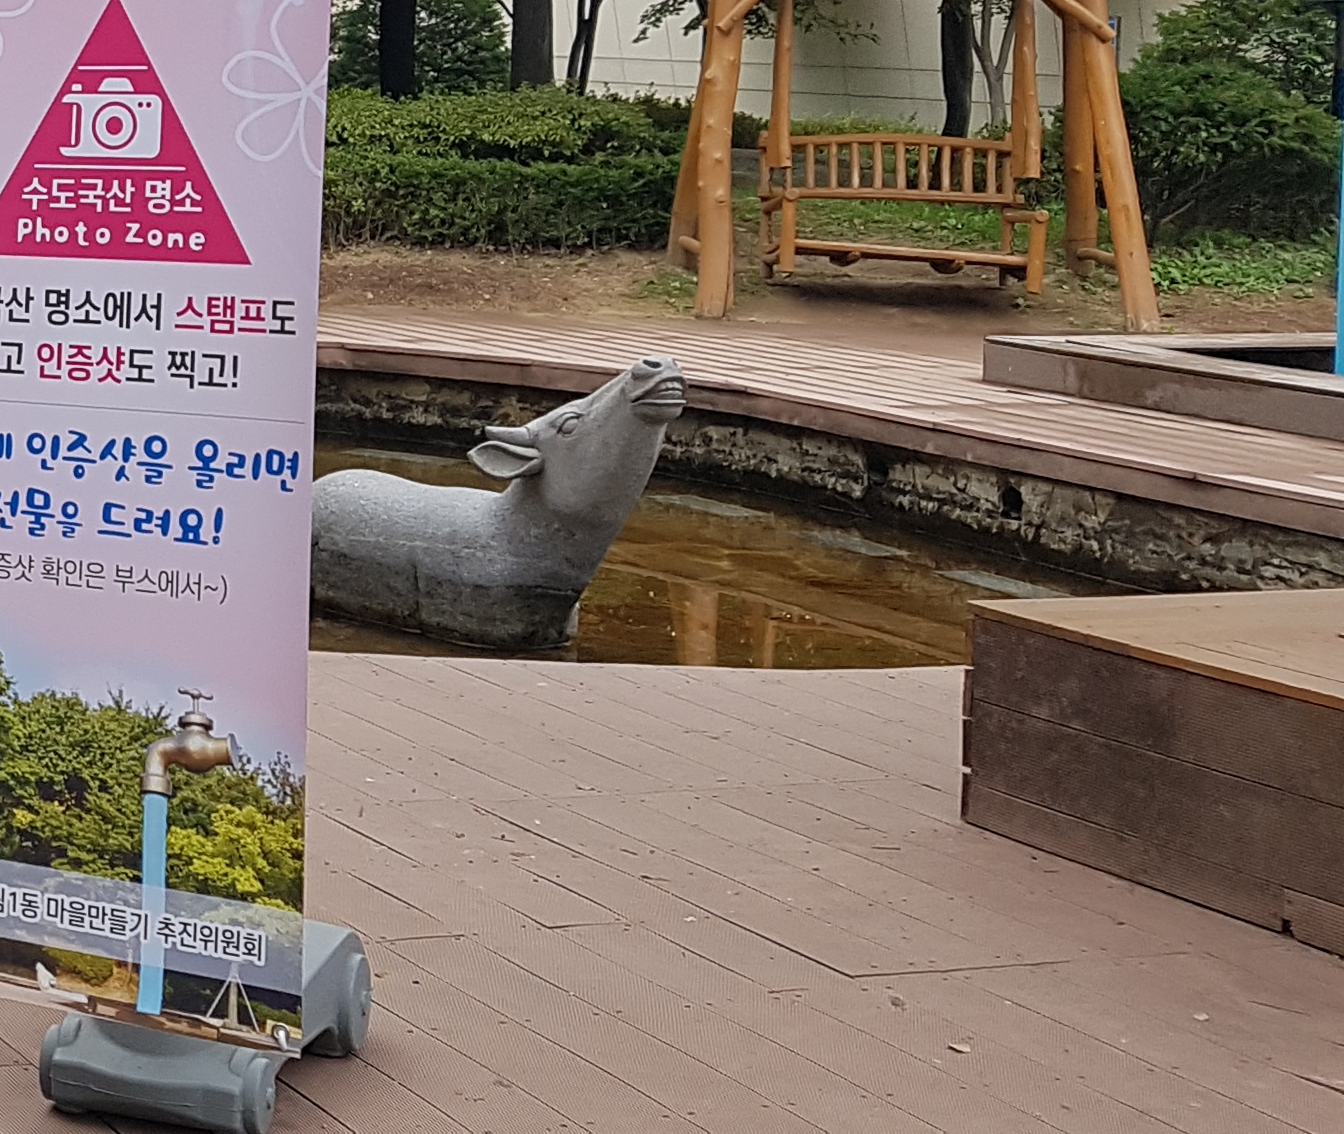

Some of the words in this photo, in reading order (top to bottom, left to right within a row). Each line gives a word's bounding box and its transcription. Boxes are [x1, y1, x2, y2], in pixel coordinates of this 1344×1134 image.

[21, 177, 135, 213] 수도국산
[144, 179, 203, 215] 명소
[16, 217, 111, 247] Photo
[124, 222, 206, 251] Zone
[44, 289, 163, 331] 명소에서
[174, 294, 297, 336] 스탬프도
[36, 342, 155, 385] 인증샷도
[167, 350, 239, 389] 찍고!
[26, 430, 173, 485] 인증샷을
[188, 438, 300, 493] 올리면
[97, 503, 224, 545] 드려요!
[40, 556, 106, 591] 확인은
[113, 565, 228, 606] 부스에서~)
[47, 897, 149, 941] 마을만들기
[157, 917, 263, 962] 추진위원회
